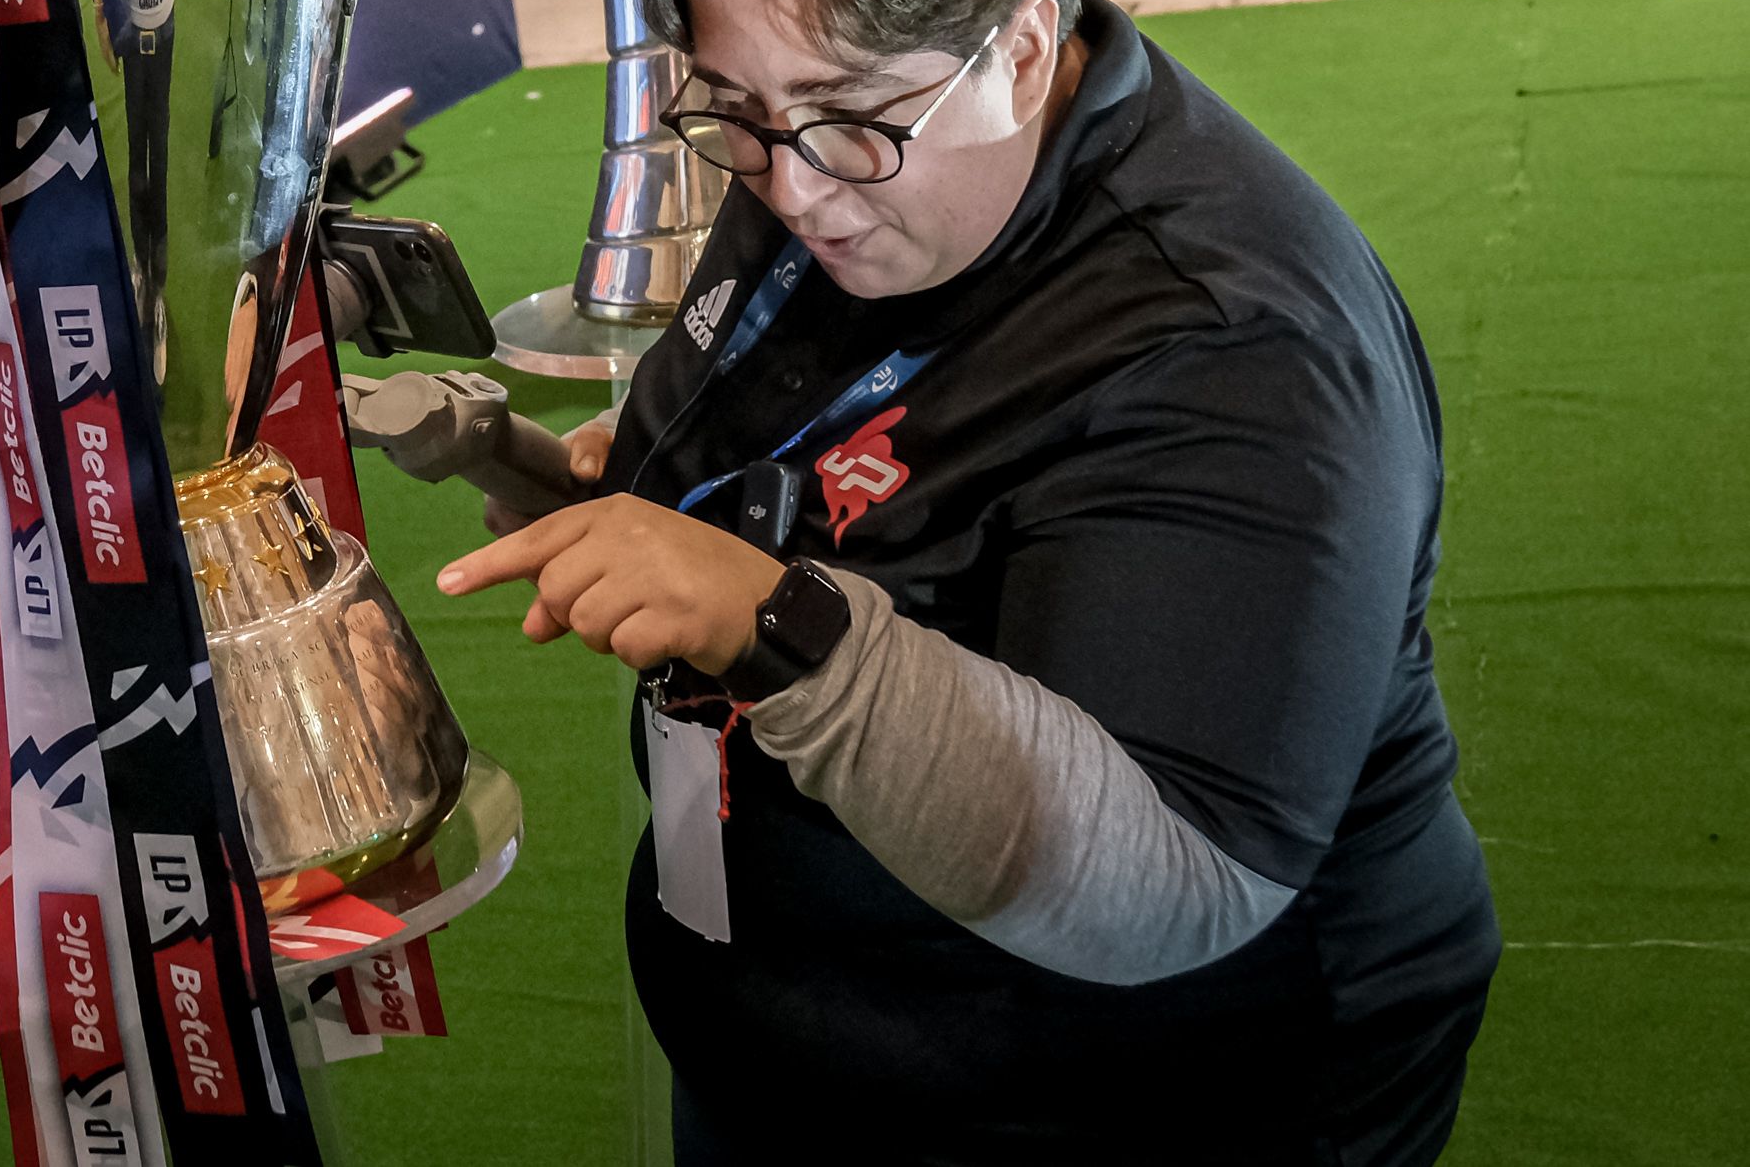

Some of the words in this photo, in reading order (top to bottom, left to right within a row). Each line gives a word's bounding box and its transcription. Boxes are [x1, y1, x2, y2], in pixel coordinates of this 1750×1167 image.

[55, 308, 94, 348] LP
[683, 304, 714, 351] adidas
[1, 360, 33, 505] Betclic
[76, 422, 124, 567] Betclic
[25, 575, 51, 615] LP
[150, 855, 191, 893] LP
[57, 911, 104, 1052] Betclic
[170, 963, 224, 1100] Betclic
[84, 1118, 127, 1155] LP
